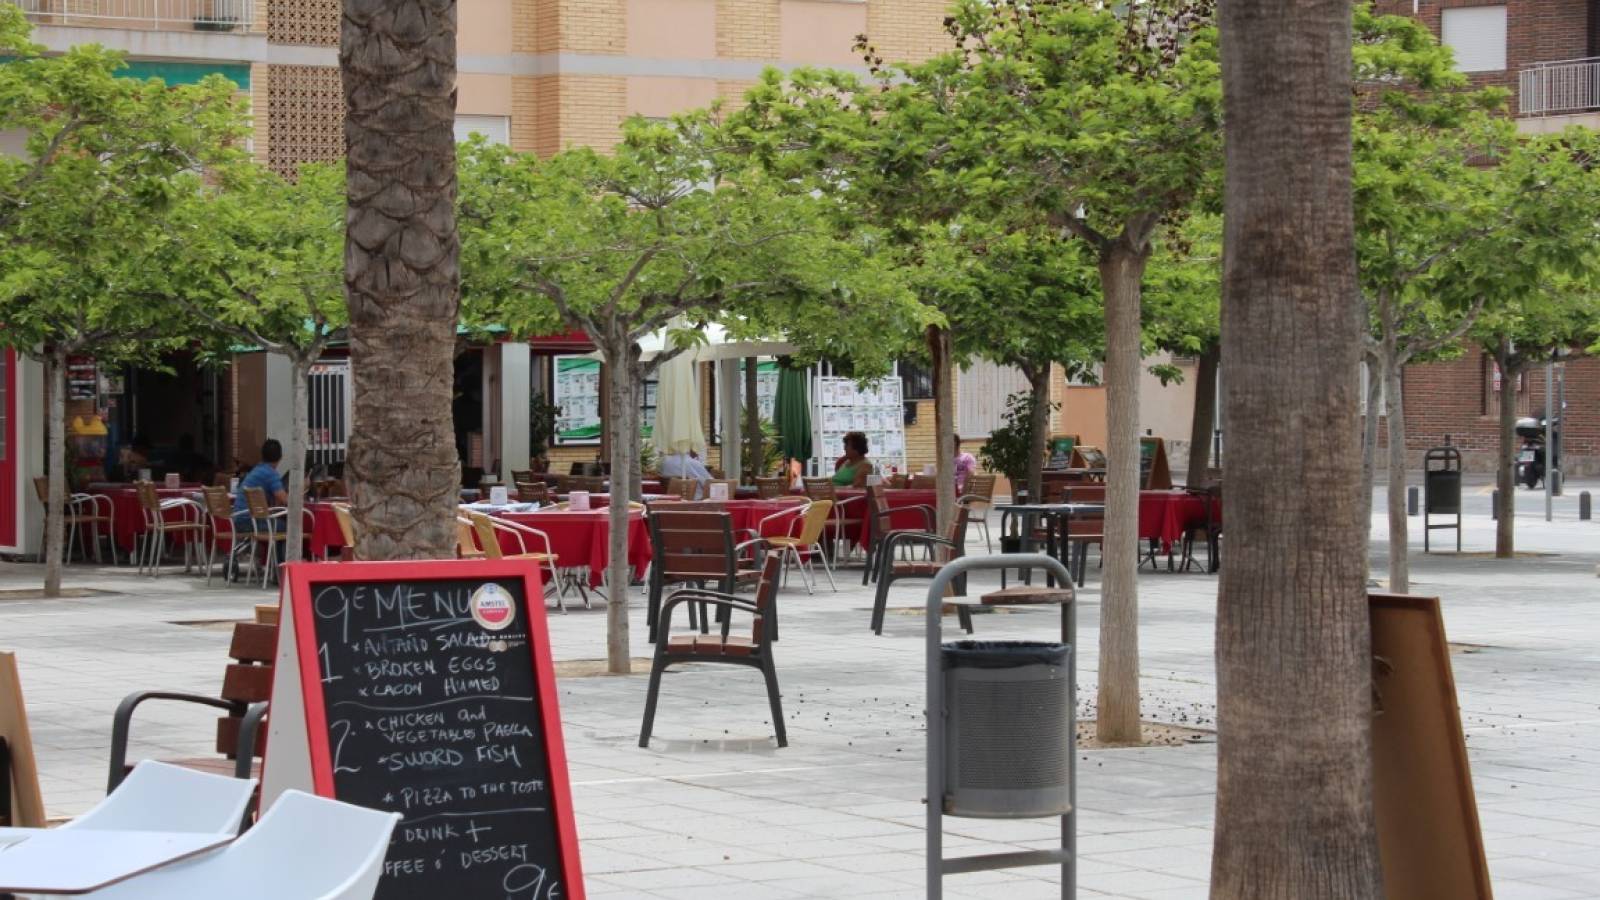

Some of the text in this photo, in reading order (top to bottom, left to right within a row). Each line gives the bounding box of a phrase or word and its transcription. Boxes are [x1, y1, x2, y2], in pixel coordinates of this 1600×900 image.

[374, 585, 472, 629] MENU
[436, 630, 490, 651] SALAD
[319, 642, 343, 683] 1
[365, 656, 497, 680] BROKEN EGGS
[444, 676, 500, 697] HUMED
[377, 704, 487, 732] CHICKEN and
[483, 721, 533, 743] PAELLA
[389, 744, 522, 772] SWORD FISH
[400, 786, 453, 809] PIZZA
[459, 787, 476, 799] TO
[481, 783, 505, 795] THE
[405, 825, 460, 842] DRINK
[385, 859, 425, 878] FFEE
[461, 844, 528, 869] DESSERT
